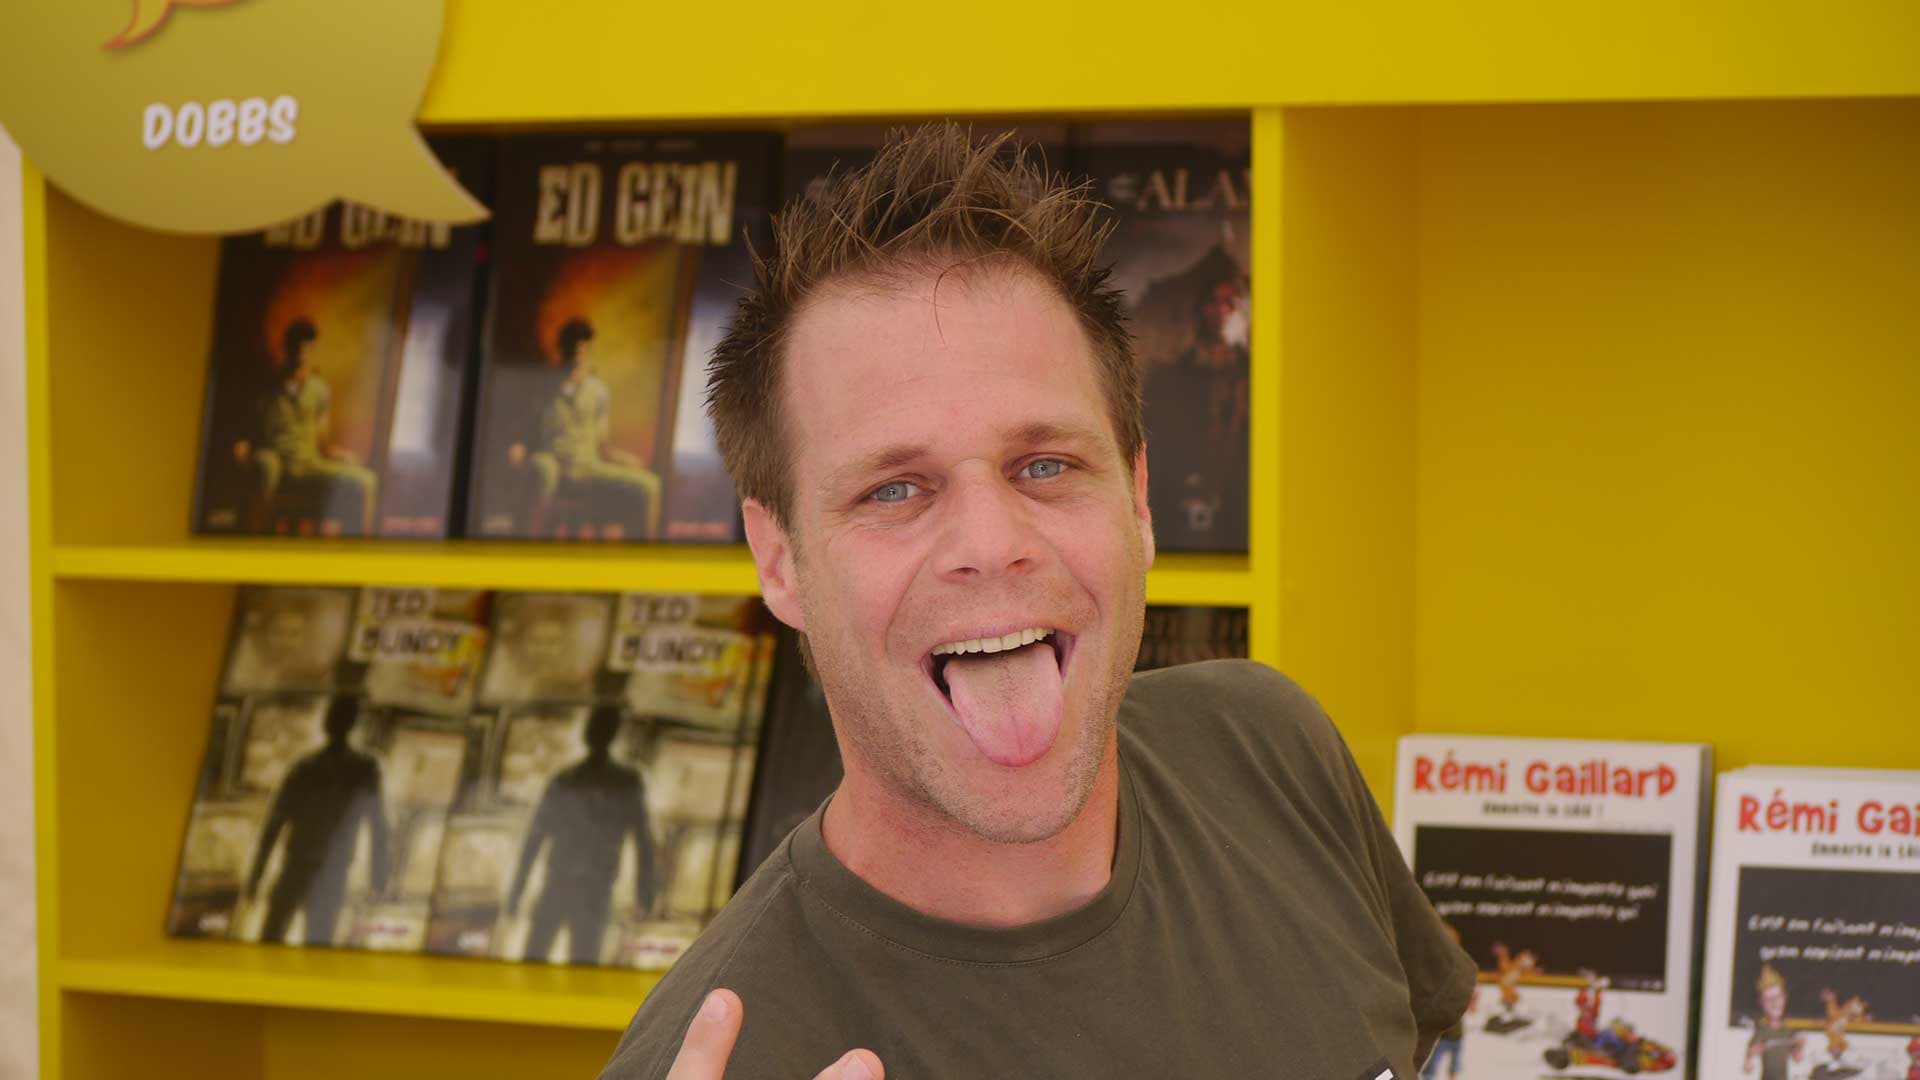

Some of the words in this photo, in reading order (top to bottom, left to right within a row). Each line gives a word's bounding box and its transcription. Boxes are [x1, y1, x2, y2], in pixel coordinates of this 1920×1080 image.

[142, 95, 298, 151] DOBBS
[532, 162, 602, 247] ED
[614, 160, 738, 247] GEIN
[1136, 167, 1251, 211] ALA
[1413, 749, 1508, 794] Rémi
[1738, 788, 1838, 834] Rémi
